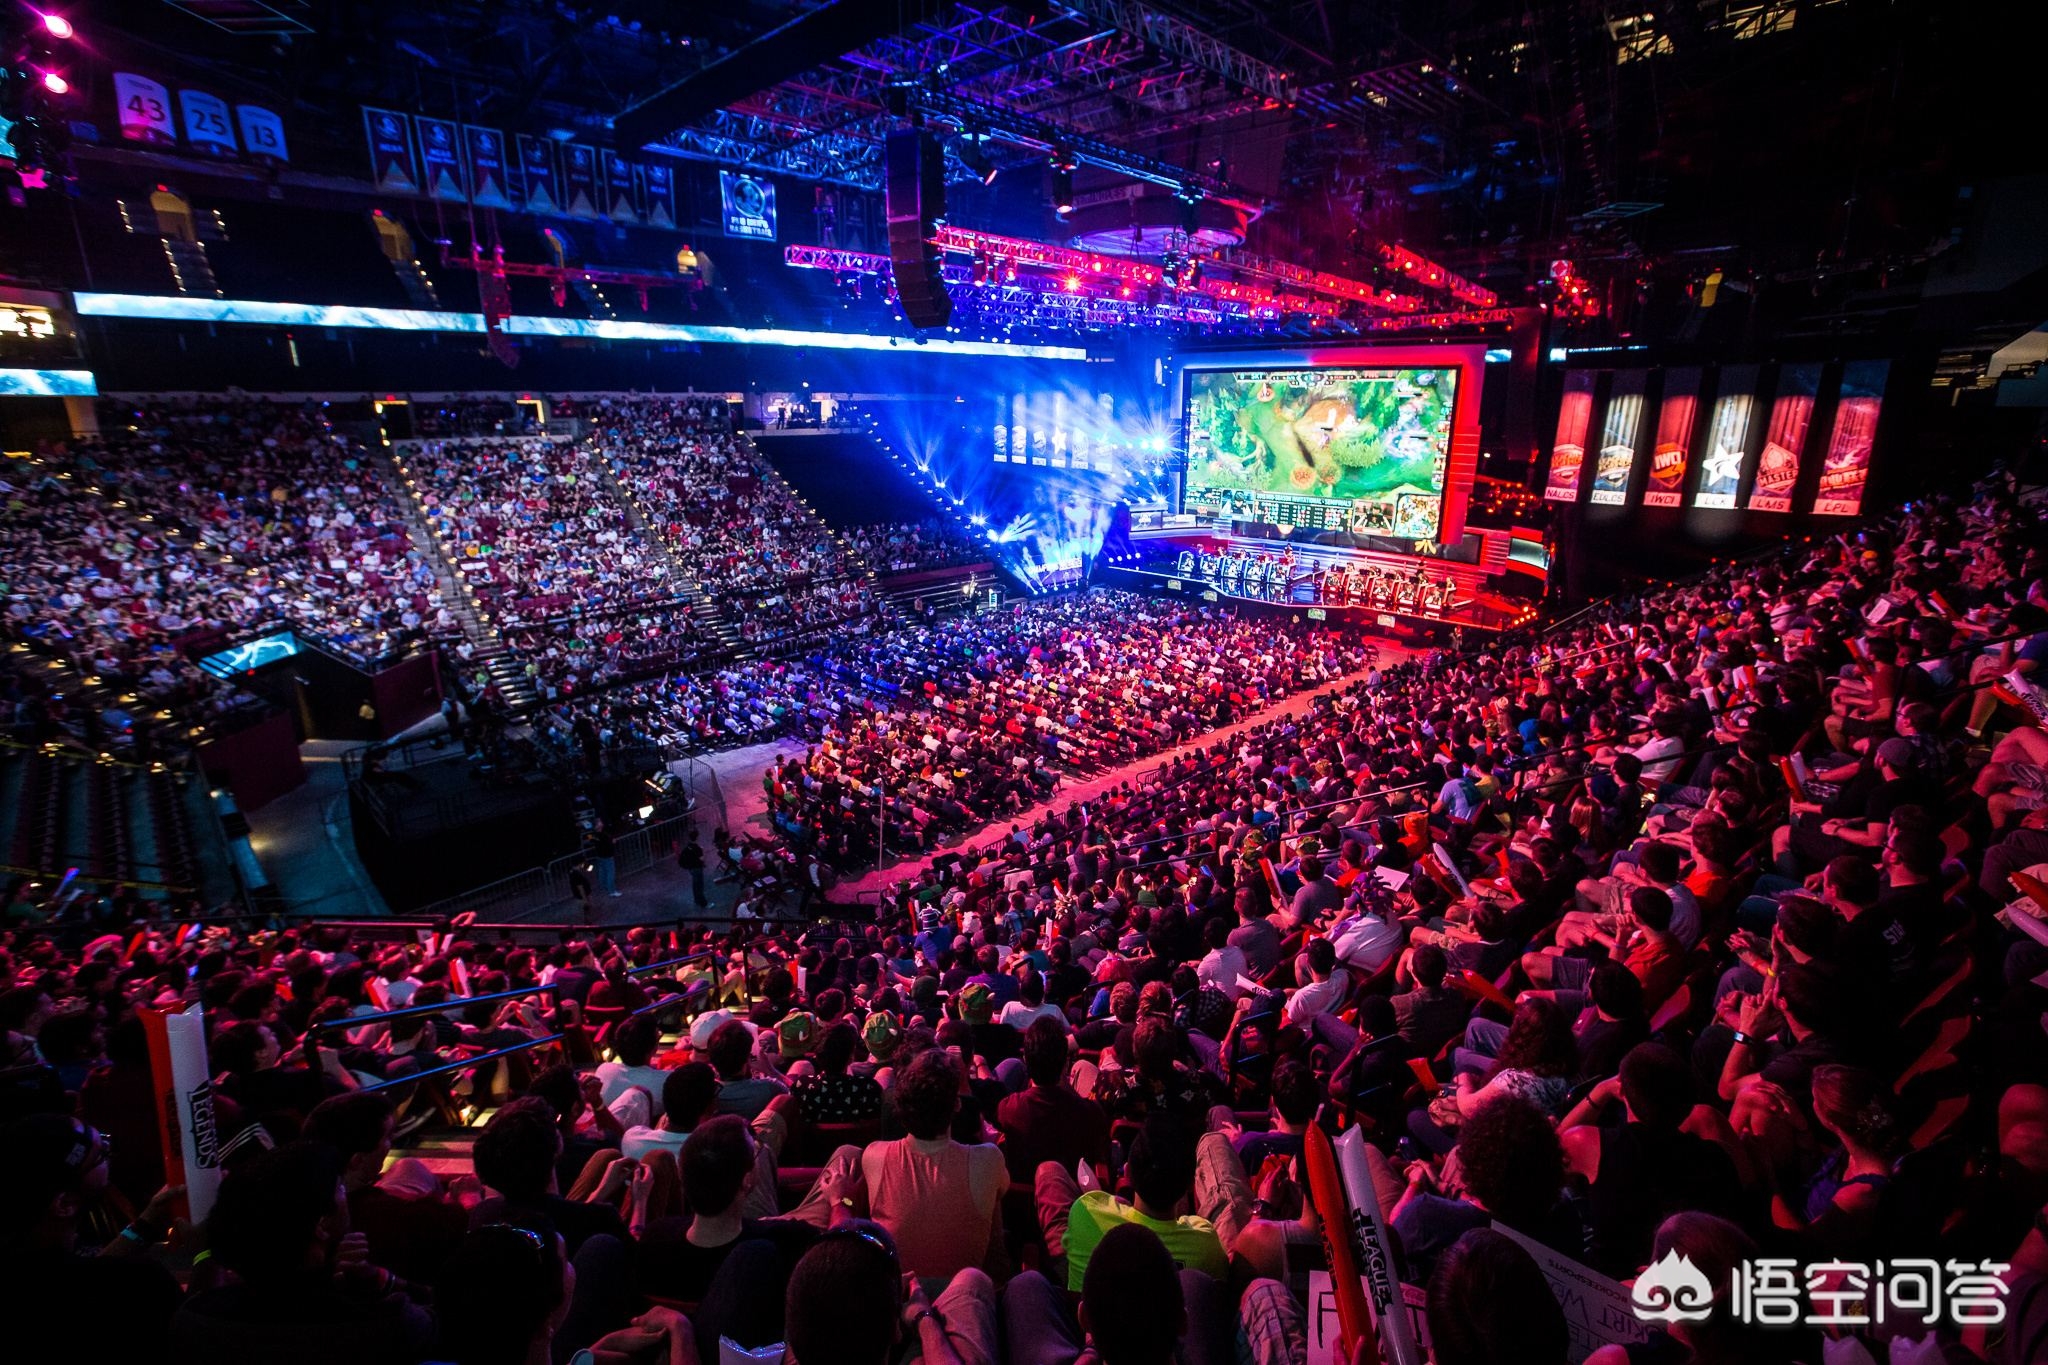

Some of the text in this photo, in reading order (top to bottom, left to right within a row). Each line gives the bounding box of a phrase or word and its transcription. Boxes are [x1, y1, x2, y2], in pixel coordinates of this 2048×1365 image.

[127, 94, 165, 122] 43
[191, 109, 226, 136] 25
[250, 125, 277, 148] 13
[1757, 500, 1785, 510] LMS
[1824, 503, 1849, 513] LPL
[188, 1085, 216, 1168] LEGENDS
[1362, 1224, 1390, 1296] LEAGUE
